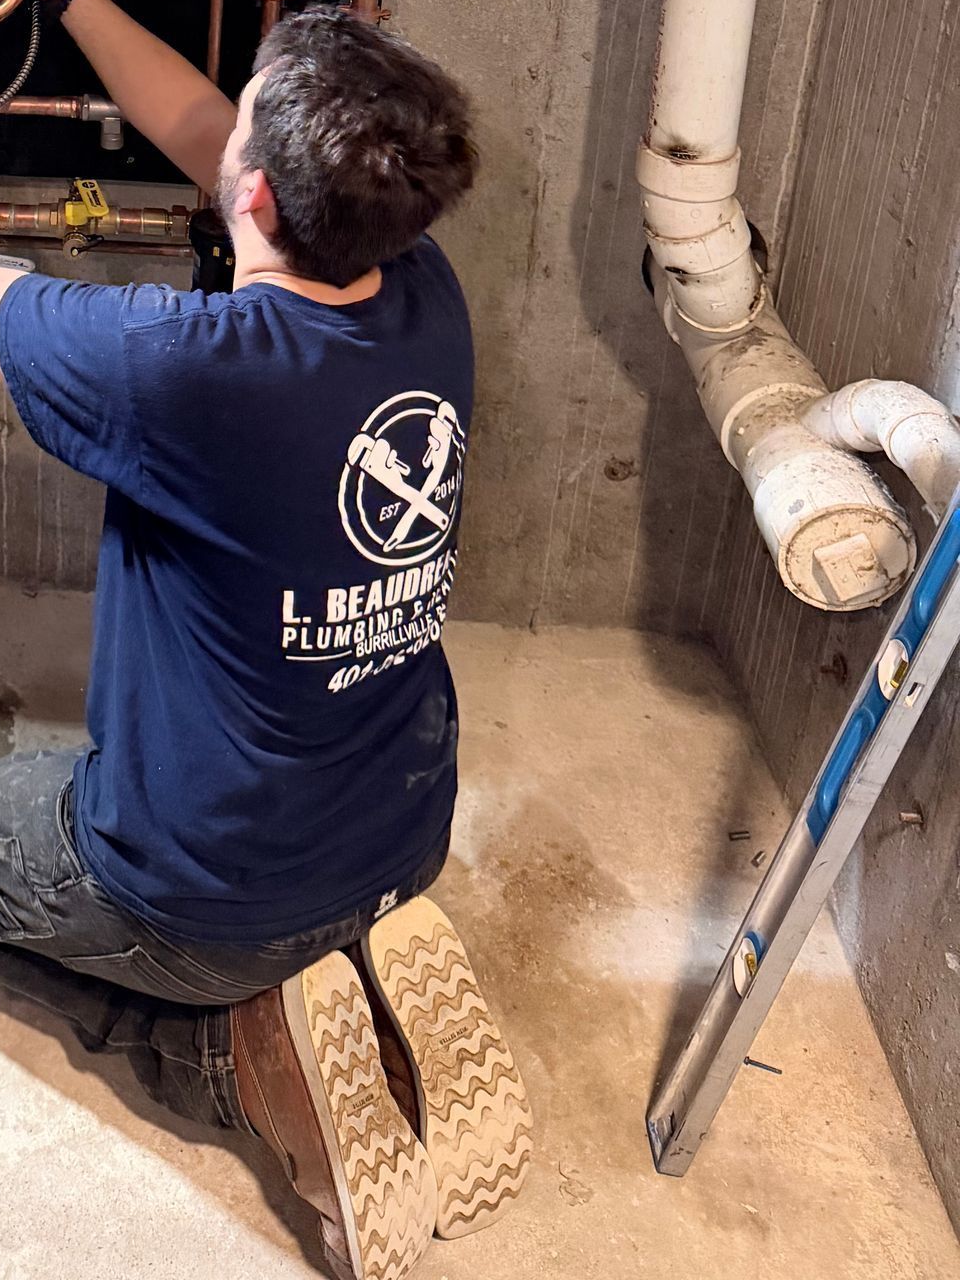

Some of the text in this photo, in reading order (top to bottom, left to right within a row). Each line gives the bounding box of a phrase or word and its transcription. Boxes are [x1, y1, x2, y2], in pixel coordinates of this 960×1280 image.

[378, 475, 455, 522] EST 2014
[281, 607, 404, 650] PLUMBING
[282, 590, 312, 624] L.
